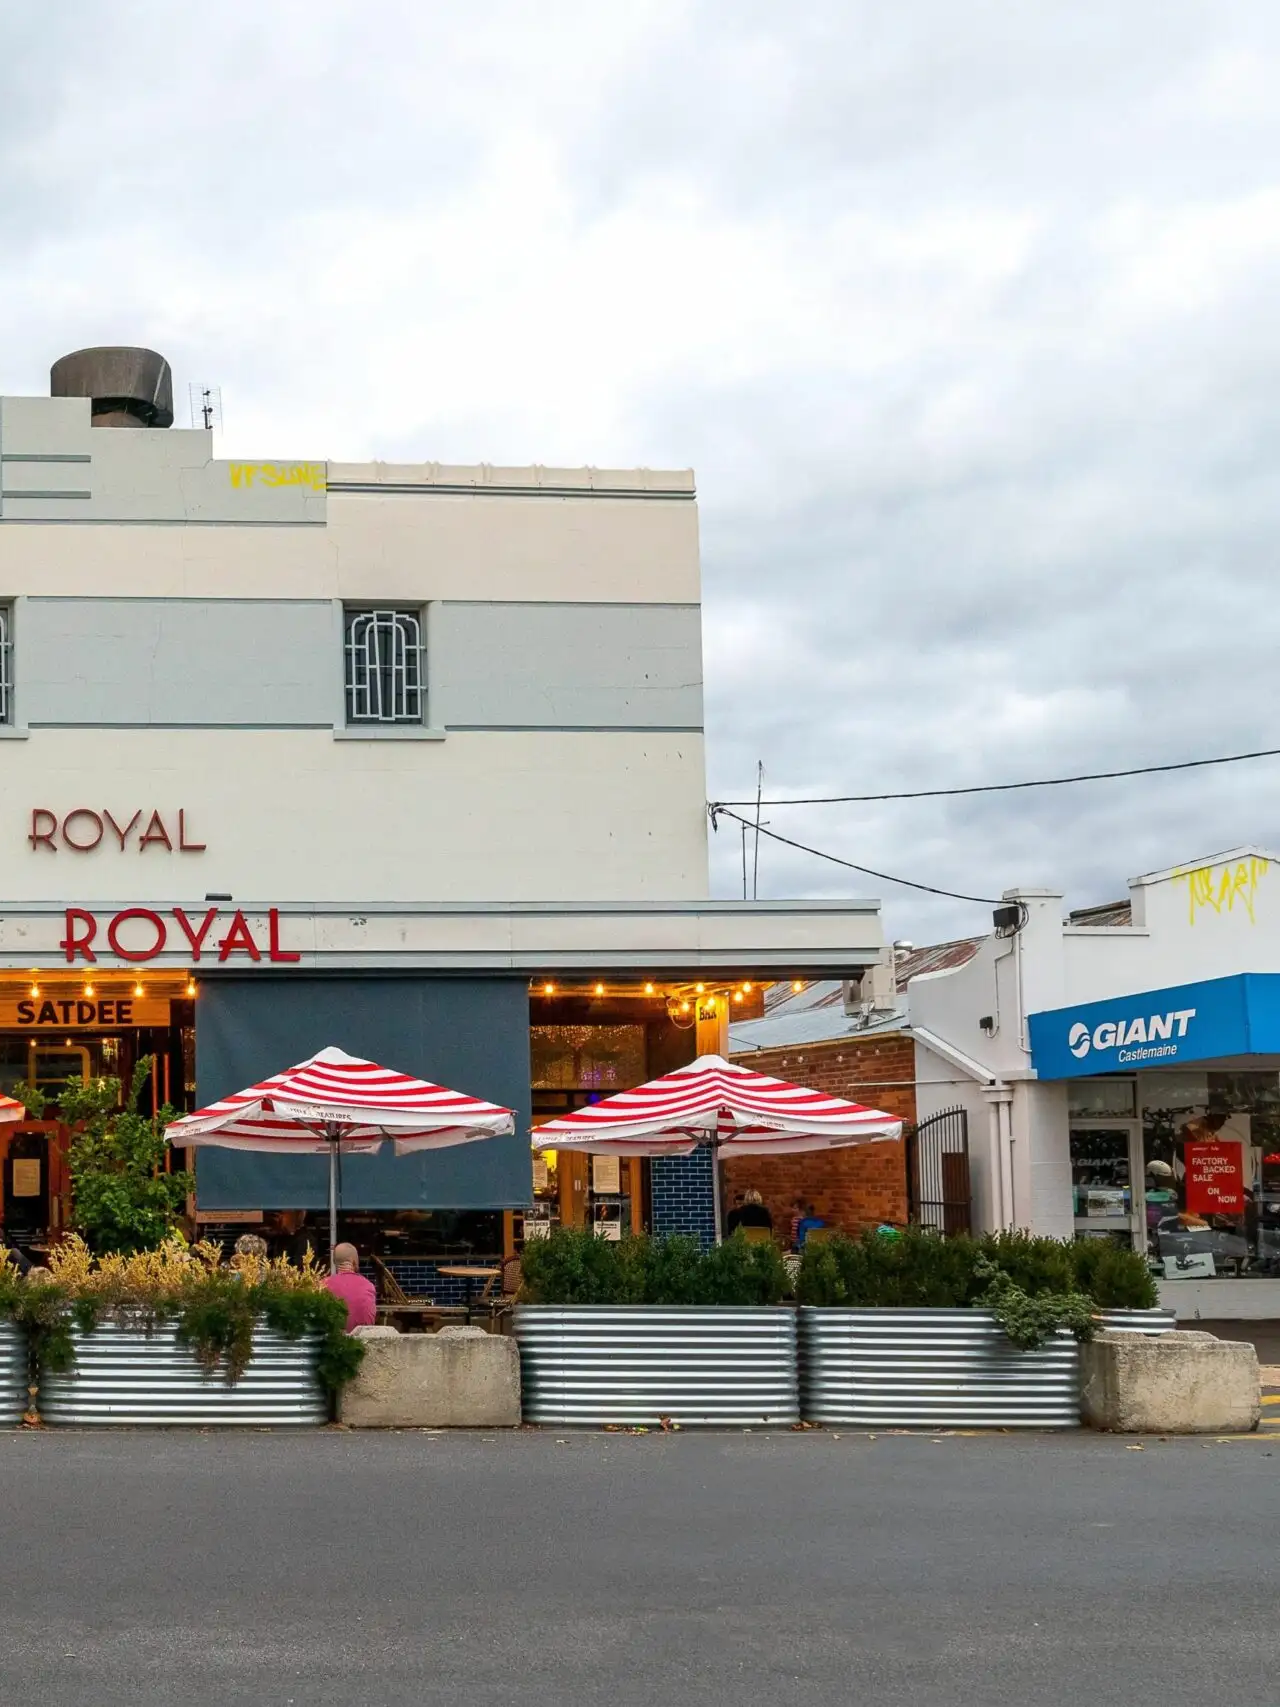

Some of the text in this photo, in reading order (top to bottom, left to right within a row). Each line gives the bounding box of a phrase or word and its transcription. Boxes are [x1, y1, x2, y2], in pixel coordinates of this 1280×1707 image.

[27, 808, 207, 852] ROYAL
[60, 907, 301, 963] ROYAL
[17, 1000, 133, 1024] SATDEE
[1092, 1008, 1196, 1050] GIANT
[1118, 1044, 1178, 1063] Castlemaine
[1192, 1157, 1228, 1165] FACTORY
[1203, 1165, 1236, 1173] BACKED
[1193, 1174, 1213, 1182] SALE
[1207, 1187, 1220, 1195] ON
[1218, 1195, 1237, 1203] NOW
